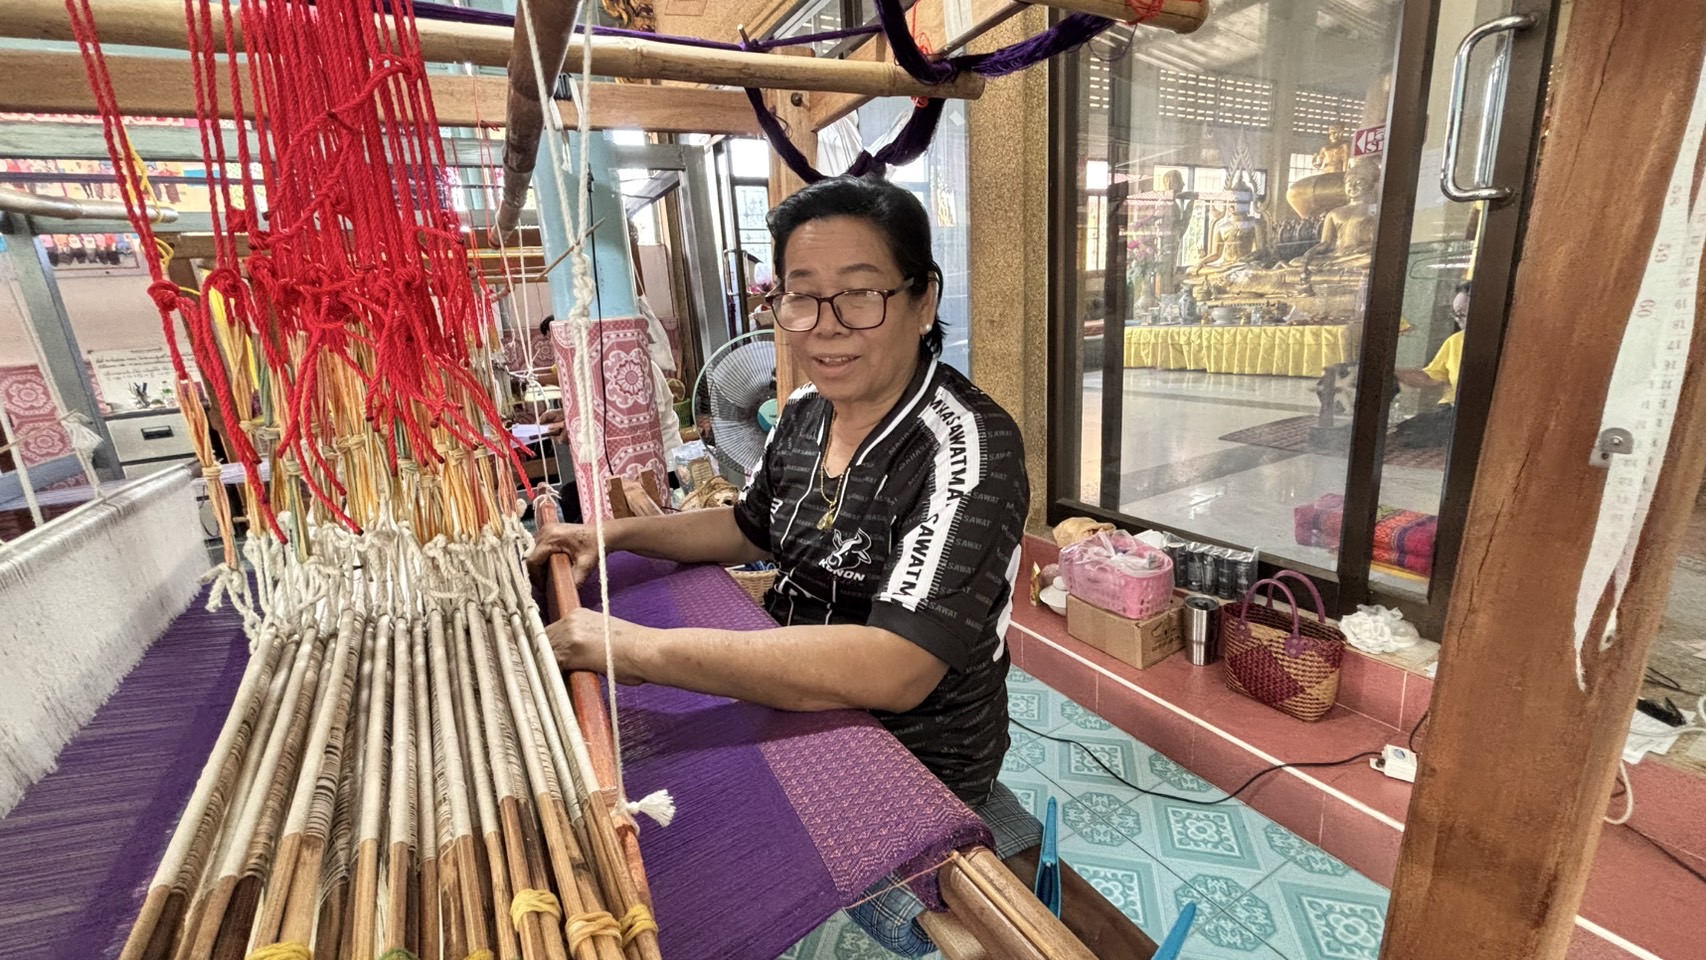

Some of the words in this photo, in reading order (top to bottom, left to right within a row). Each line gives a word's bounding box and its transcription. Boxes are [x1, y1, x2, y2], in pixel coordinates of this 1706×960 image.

[1654, 242, 1672, 264] 59
[1636, 298, 1656, 319] 60
[973, 491, 1000, 504] SAWAT
[963, 514, 992, 528] SAWAT
[955, 538, 983, 551] SAWAT
[928, 601, 958, 619] SAWAT
